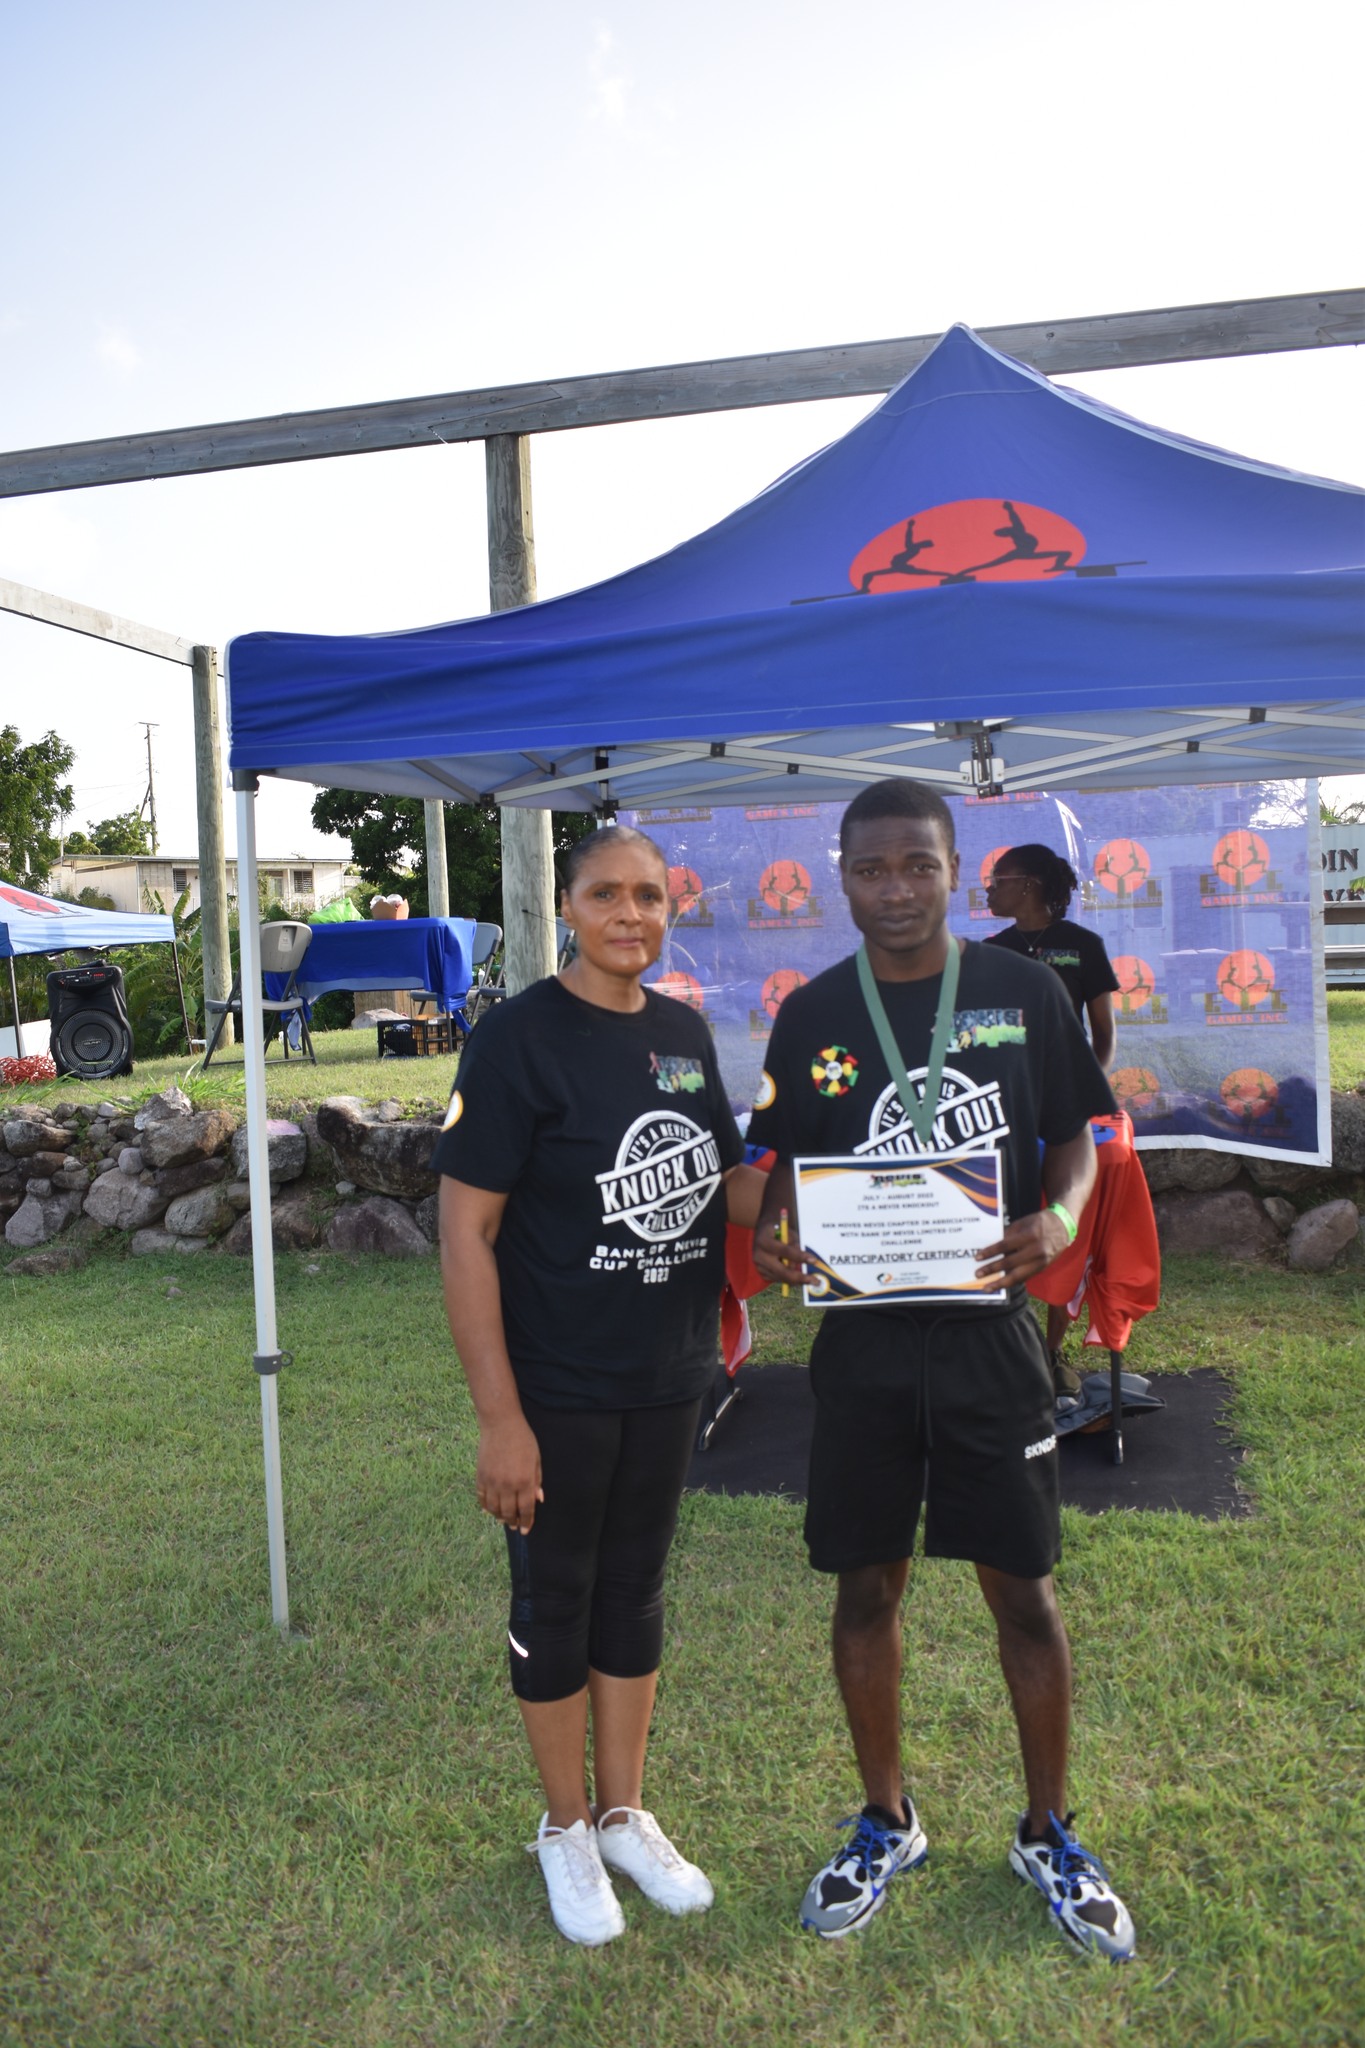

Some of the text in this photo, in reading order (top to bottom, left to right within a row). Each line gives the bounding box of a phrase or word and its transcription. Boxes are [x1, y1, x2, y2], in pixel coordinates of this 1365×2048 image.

[745, 808, 788, 820] GAMES
[1322, 848, 1359, 872] IN
[1201, 894, 1249, 906] GAMES
[748, 918, 792, 929] GAMES
[1205, 1014, 1253, 1025] GAMES
[881, 1100, 904, 1129] IT'S
[862, 1092, 1006, 1156] NOK OUT
[628, 1122, 691, 1161] IT'S A NEVIS
[600, 1153, 689, 1214] KNOCK
[643, 1191, 703, 1232] CHLLENGE
[902, 1201, 940, 1209] KNOCKOUT
[864, 1220, 886, 1228] NEVIS
[887, 1219, 919, 1227] CHAPTER
[932, 1216, 981, 1225] ASSOCIATION
[917, 1227, 946, 1235] LIMITED
[595, 1236, 709, 1259] BANK OF NEVIS
[880, 1238, 923, 1246] CHALLENGE
[589, 1247, 708, 1271] CUP CHALLENGE
[829, 1248, 982, 1265] PARTICIPATORY CERTIFICAT
[642, 1267, 670, 1285] 2023
